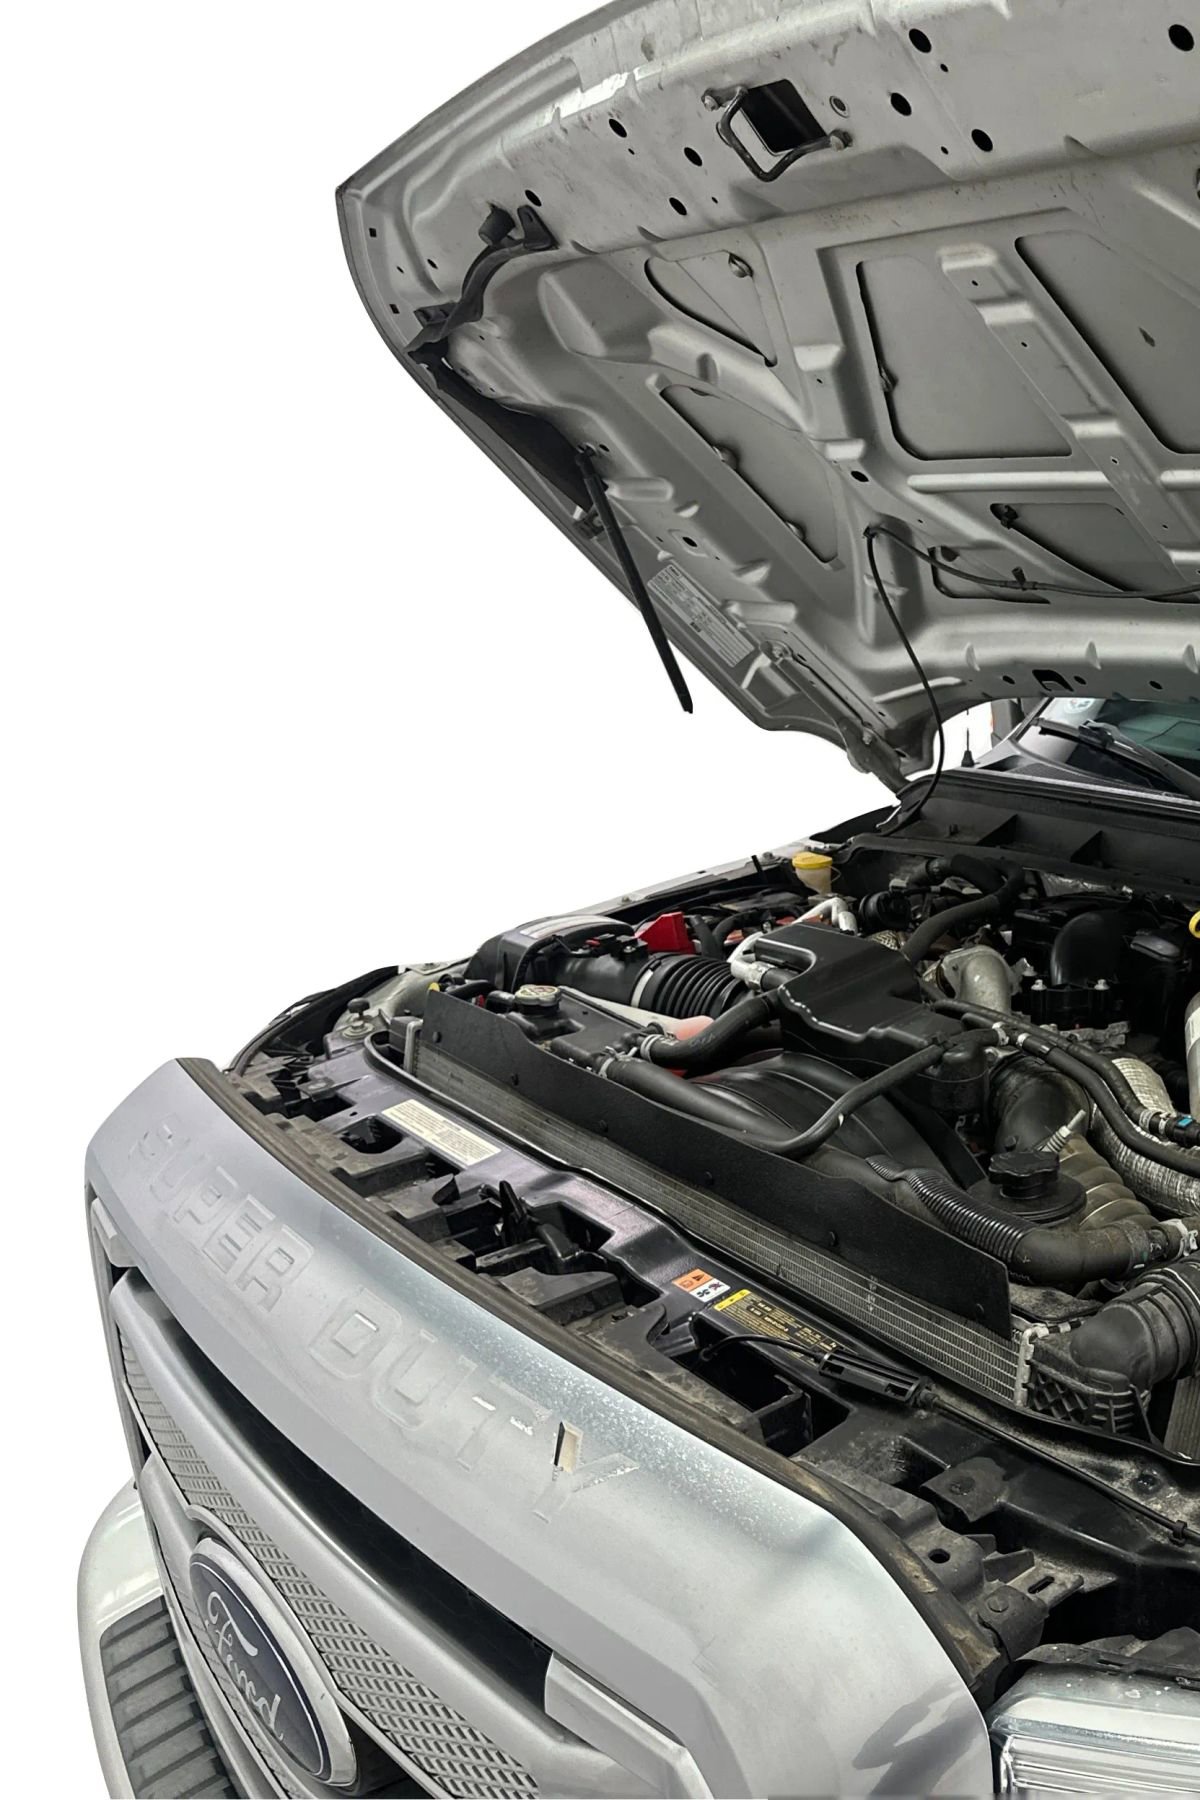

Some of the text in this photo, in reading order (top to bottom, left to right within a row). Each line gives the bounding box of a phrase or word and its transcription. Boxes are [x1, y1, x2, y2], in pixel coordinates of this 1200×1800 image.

[127, 1111, 640, 1524] SUPER DUTY
[205, 1591, 284, 1741] Ford
